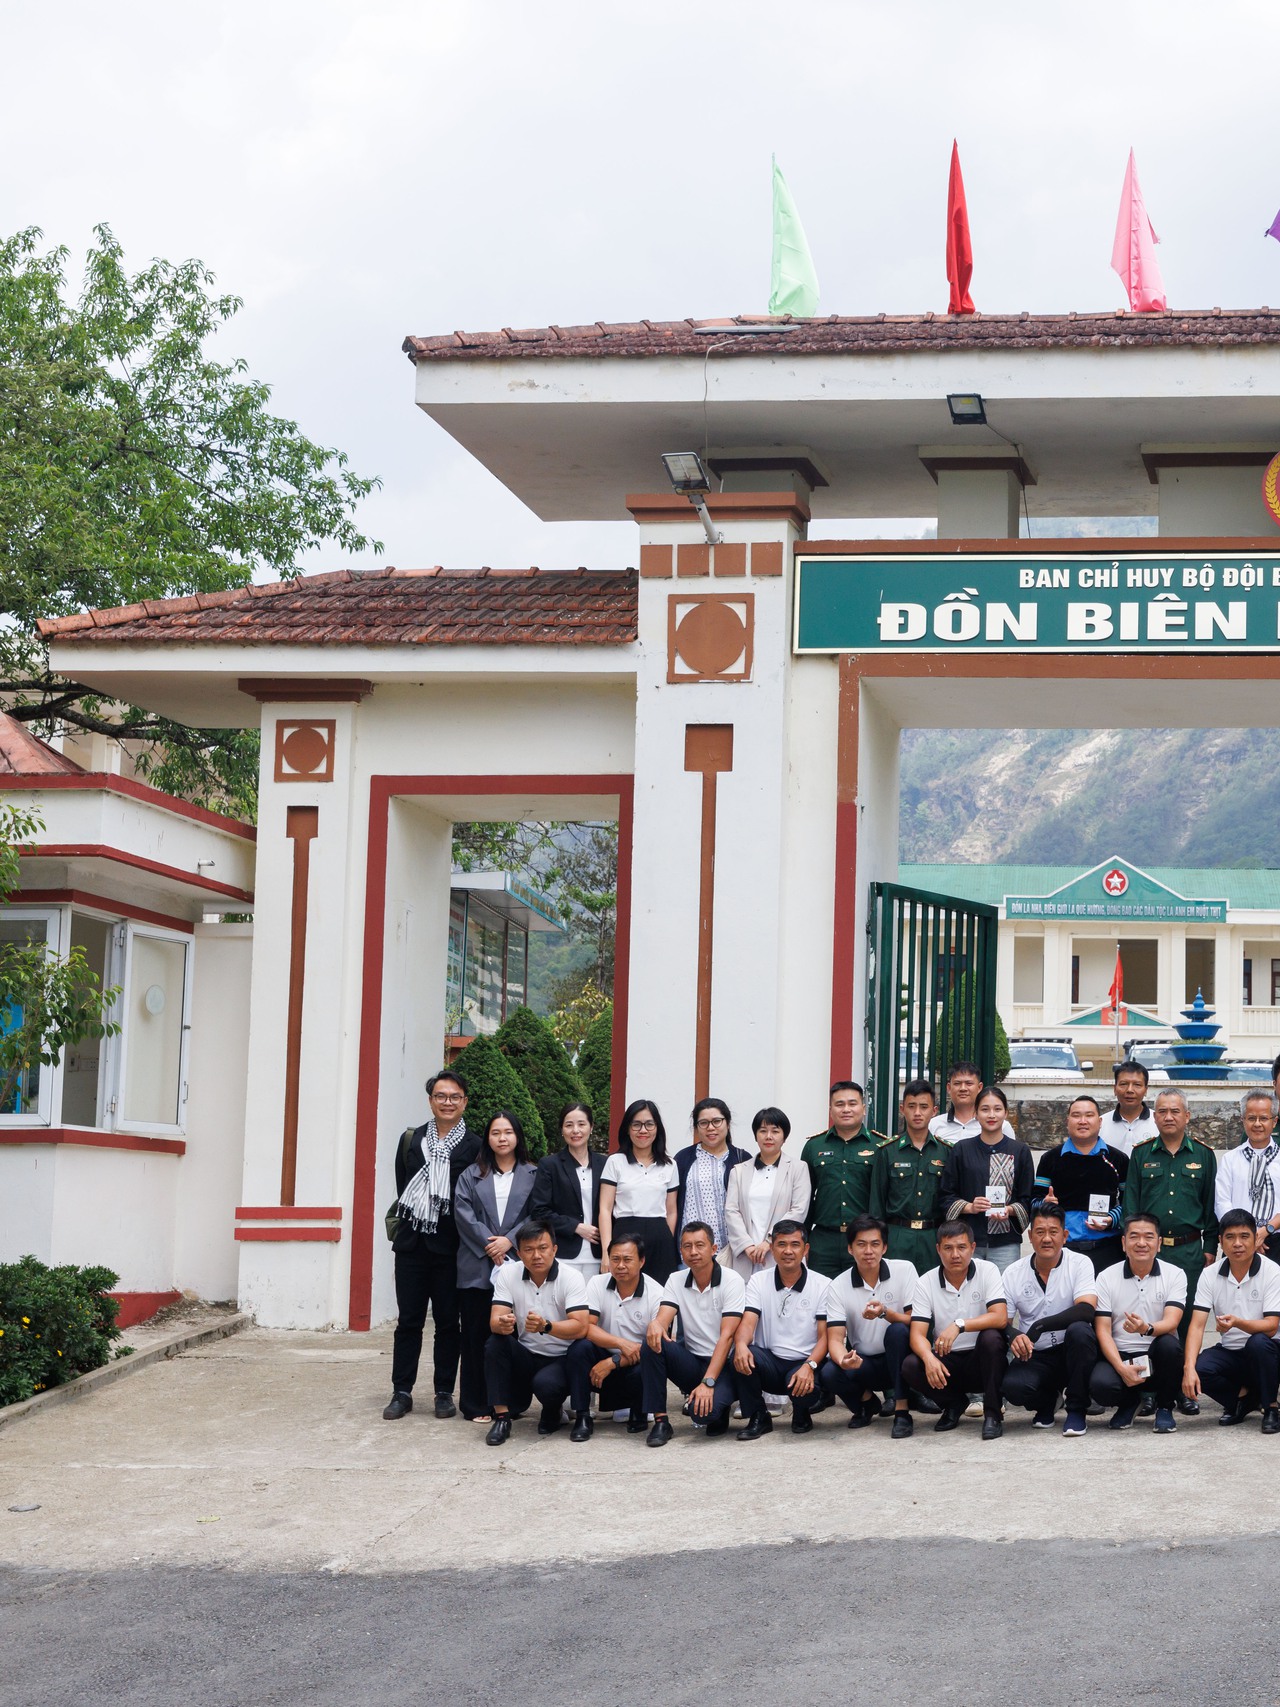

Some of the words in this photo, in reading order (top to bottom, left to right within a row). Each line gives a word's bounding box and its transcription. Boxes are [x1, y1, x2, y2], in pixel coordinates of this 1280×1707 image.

[1019, 568, 1070, 588] BAN
[1078, 561, 1120, 588] CHỈ
[1126, 567, 1175, 588] HUY
[1182, 563, 1215, 592] BỘ
[1222, 563, 1264, 592] ĐỘI
[876, 587, 1038, 641] ĐỒN
[1066, 592, 1247, 641] BIÊN
